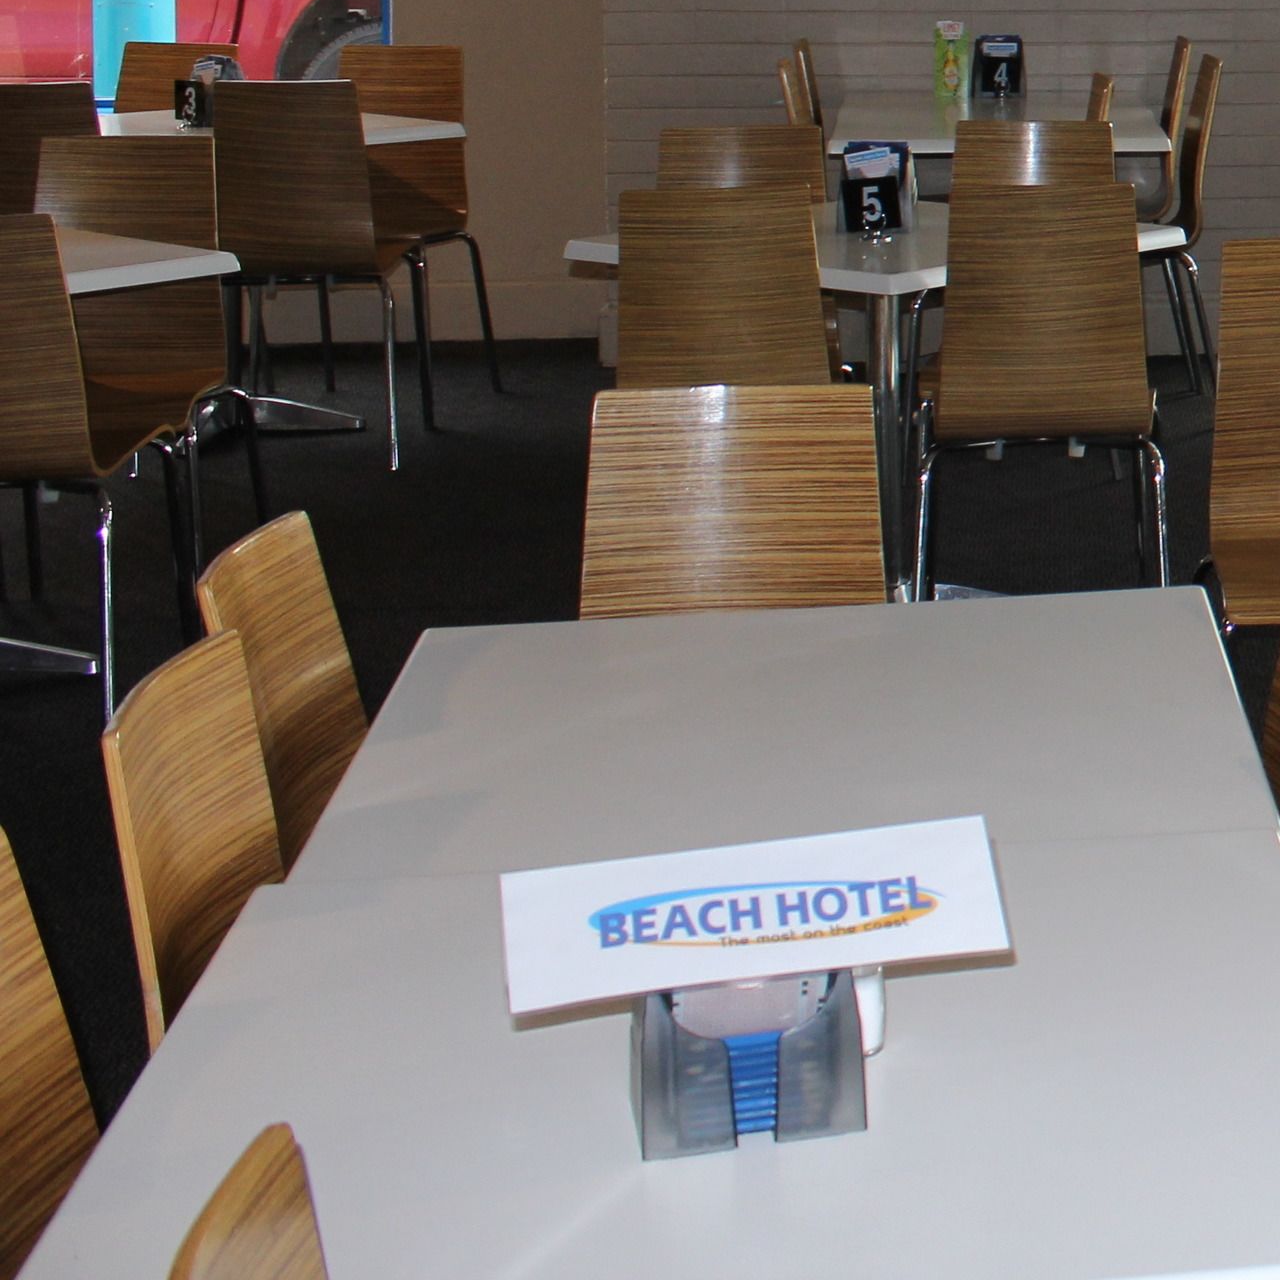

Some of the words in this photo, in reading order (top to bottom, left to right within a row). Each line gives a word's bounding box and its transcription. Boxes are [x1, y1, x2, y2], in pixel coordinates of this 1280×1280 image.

[993, 62, 1009, 88] 4
[184, 87, 197, 114] 3
[862, 185, 882, 221] 5
[599, 897, 762, 949] BEACH
[776, 875, 934, 927] HOTEL
[719, 936, 750, 949] The
[756, 930, 797, 945] most
[803, 930, 825, 939] on
[829, 922, 857, 936] the
[863, 915, 909, 932] coast
